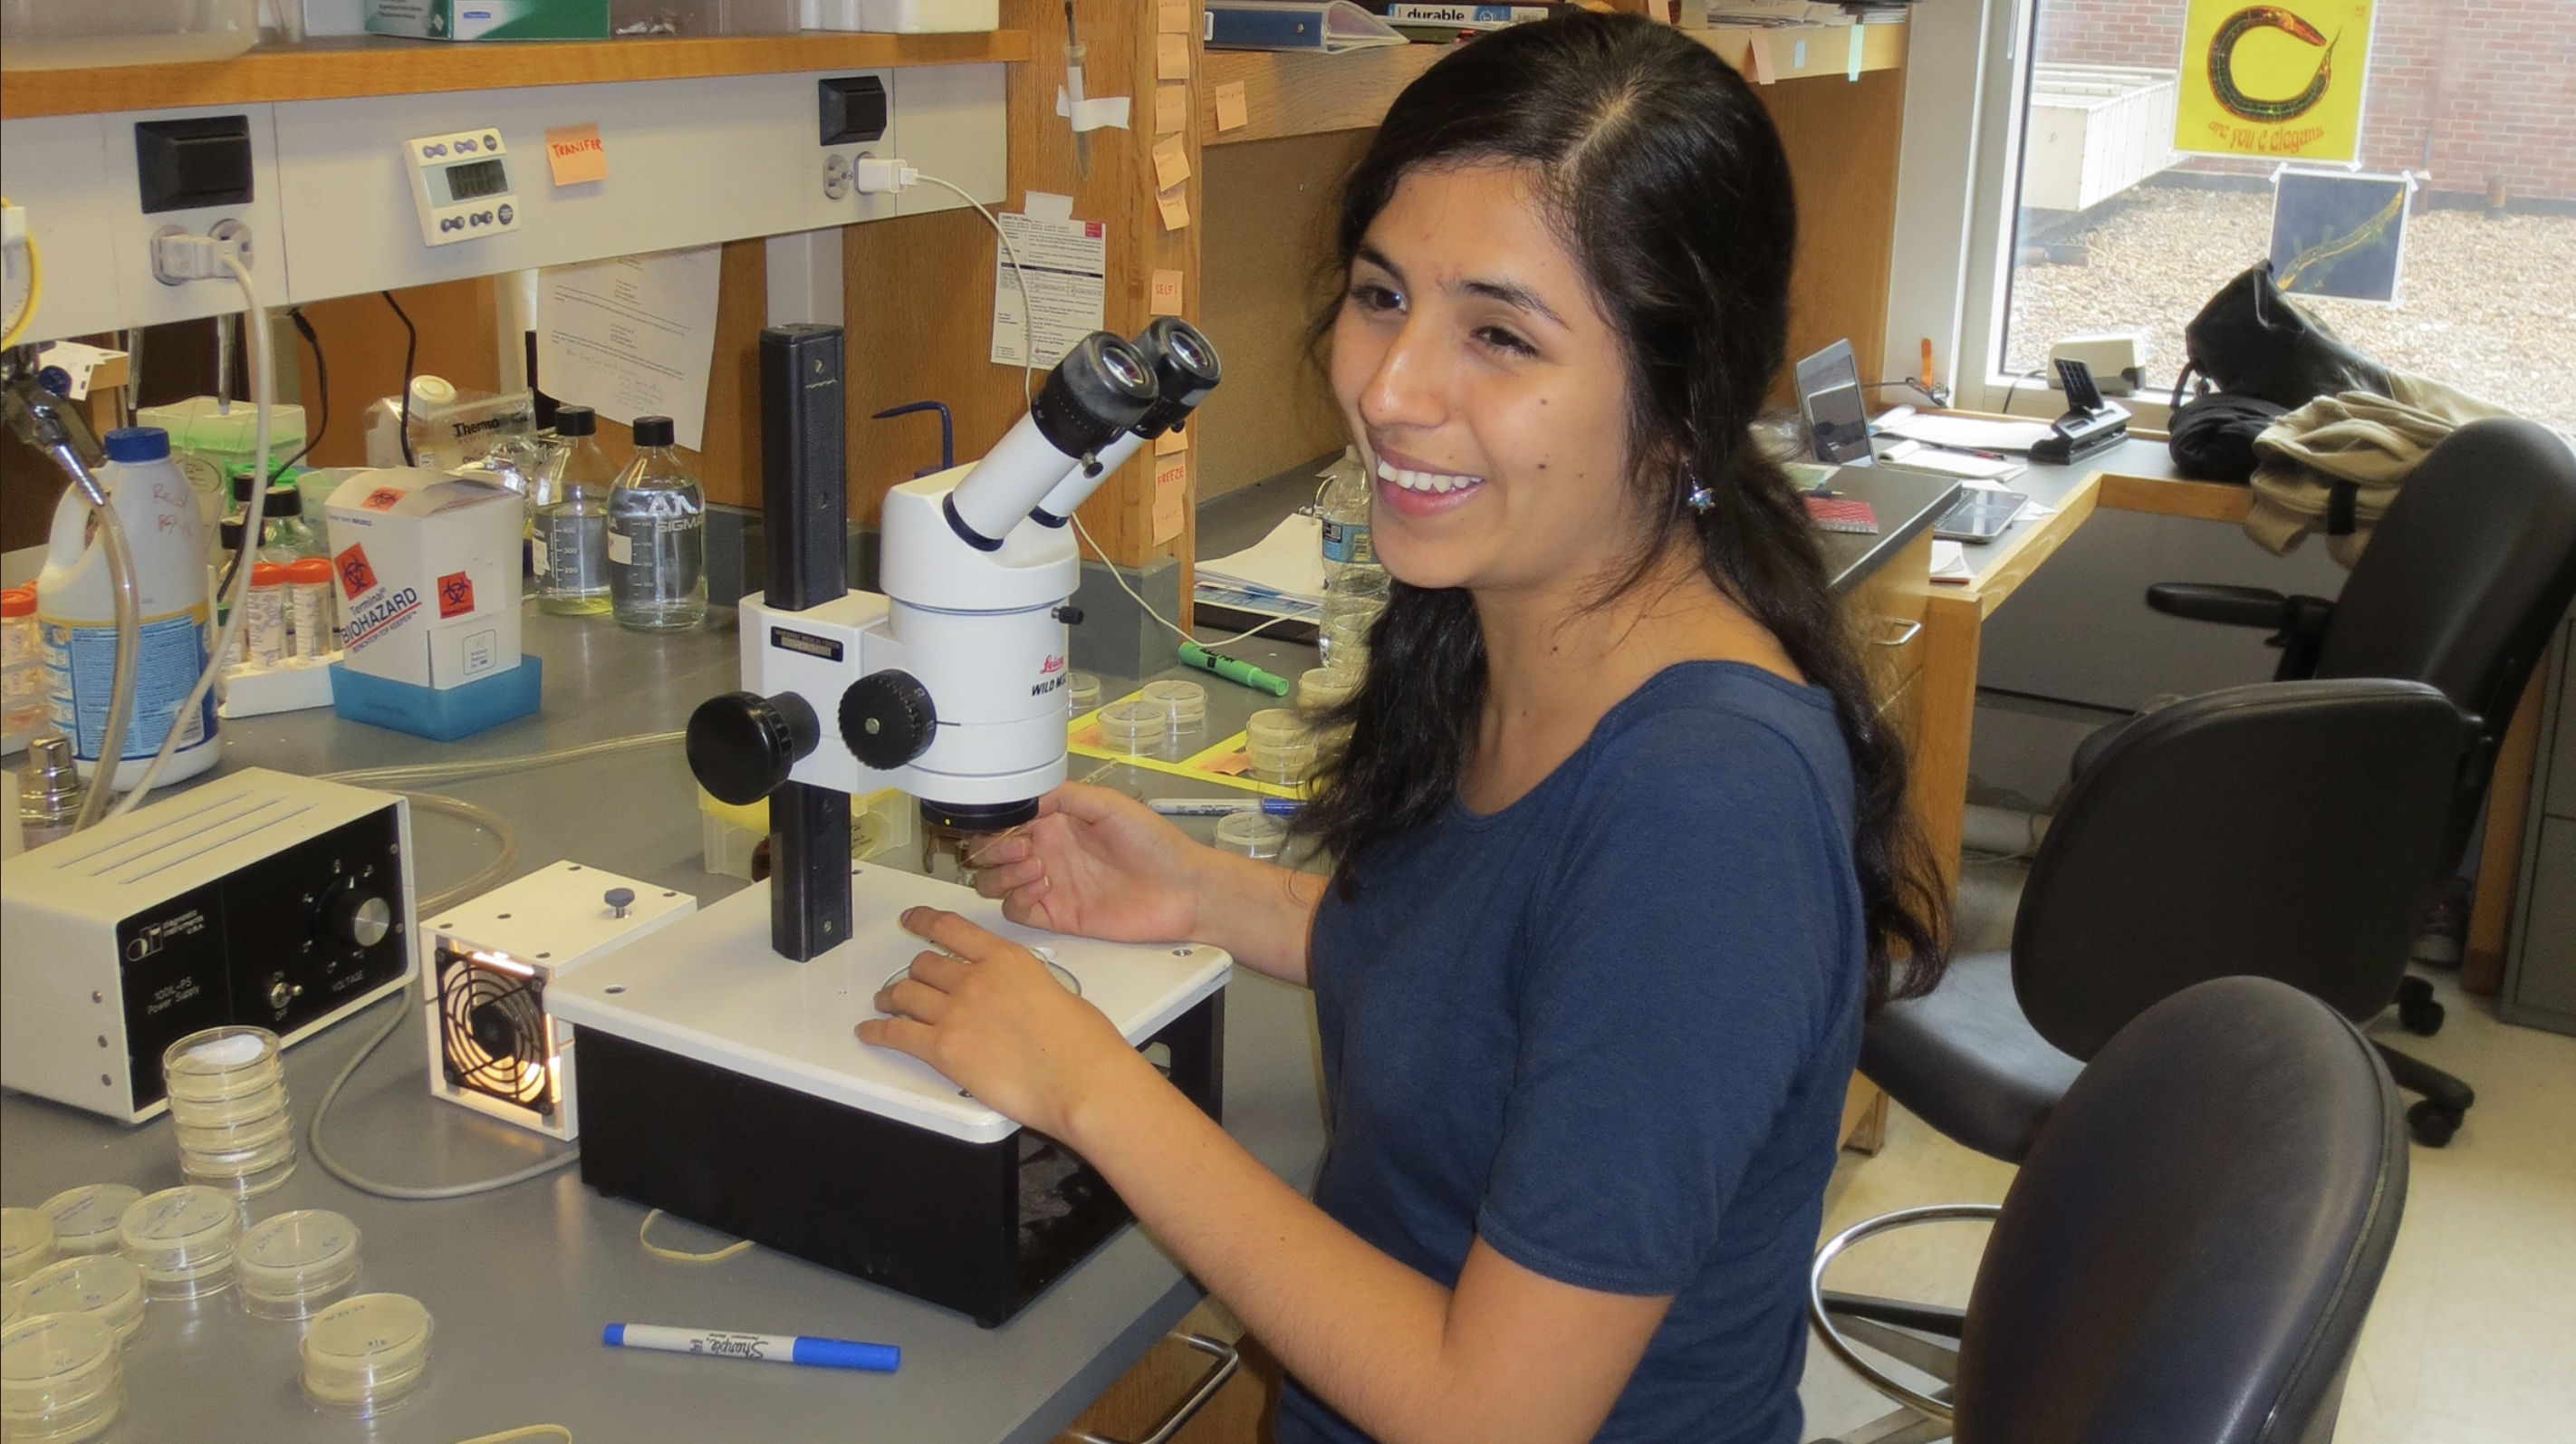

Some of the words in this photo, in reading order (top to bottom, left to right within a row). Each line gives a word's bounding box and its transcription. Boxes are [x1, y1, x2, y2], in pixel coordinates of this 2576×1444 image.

[1407, 7, 1465, 22] durable
[552, 138, 603, 159] TRANSFER
[2229, 128, 2255, 149] you
[452, 418, 500, 438] Thermo
[1157, 466, 1185, 488] FREEZE
[655, 515, 704, 533] SIGMA
[564, 566, 579, 574] 200
[341, 587, 418, 645] BIOHAZARD
[1039, 654, 1064, 675] Leica
[1032, 679, 1055, 697] WILD
[332, 969, 365, 992] VOLTAGE
